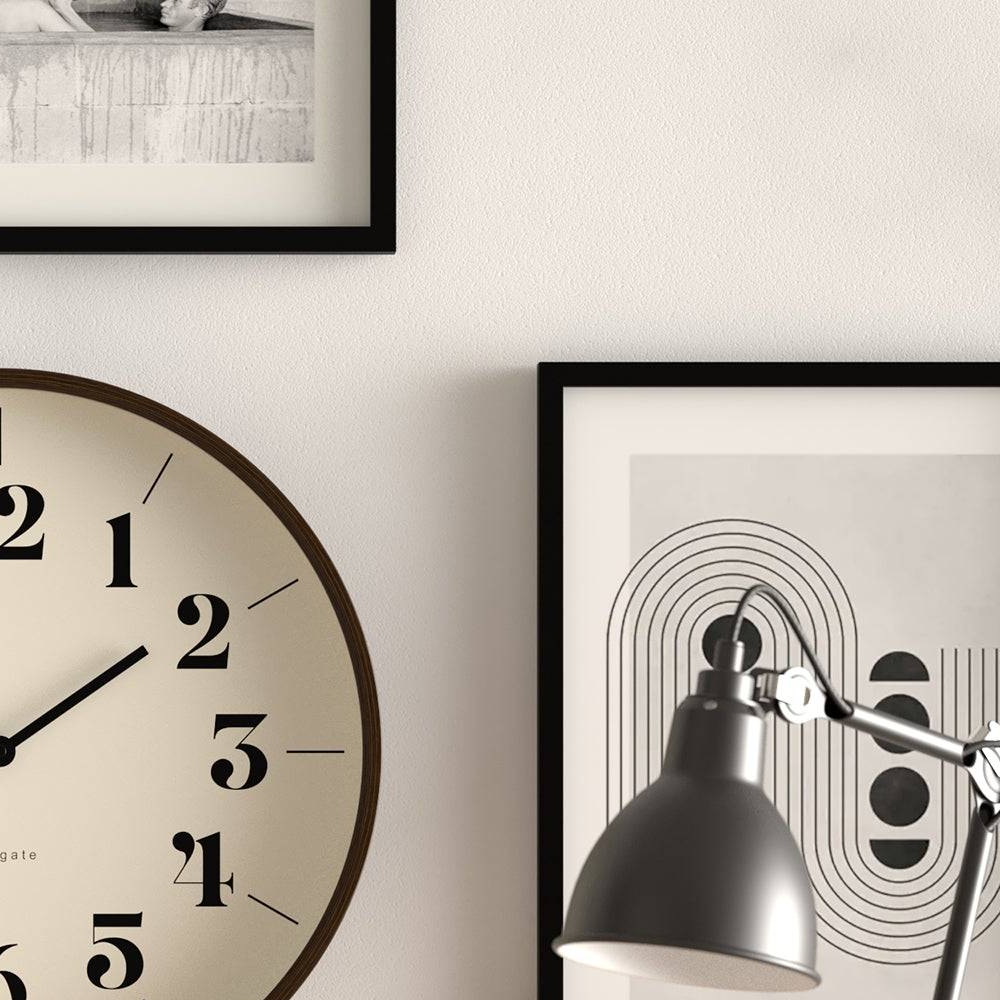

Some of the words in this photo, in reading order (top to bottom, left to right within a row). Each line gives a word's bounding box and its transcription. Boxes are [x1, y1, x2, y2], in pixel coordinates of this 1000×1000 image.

[105, 511, 138, 588] 1
[176, 593, 230, 670] 2
[210, 713, 269, 791] 3
[172, 831, 235, 907] 4
[86, 911, 144, 990] 5
